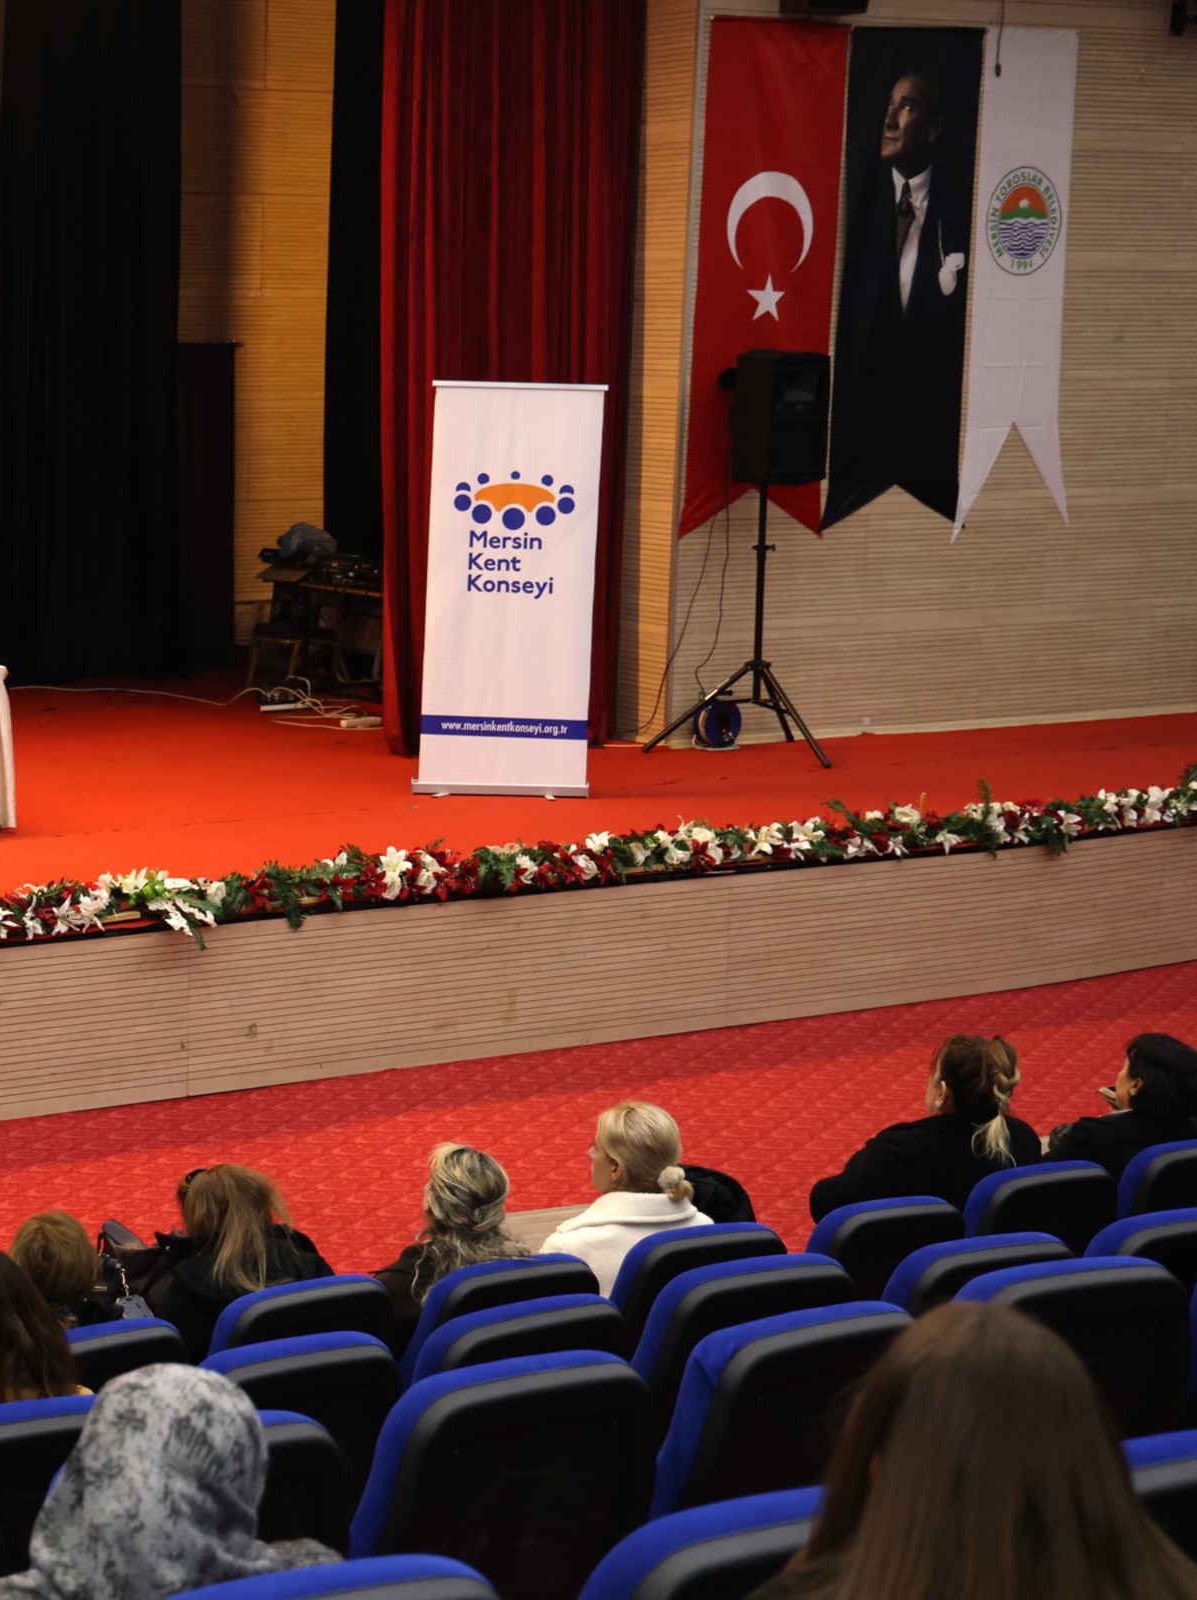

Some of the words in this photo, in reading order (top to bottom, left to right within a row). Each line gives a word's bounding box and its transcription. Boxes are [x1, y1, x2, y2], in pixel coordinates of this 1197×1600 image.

[996, 172, 1043, 202] TOROSLAR
[468, 530, 543, 550] Mersin
[467, 552, 521, 572] Kent
[467, 573, 554, 600] Konseyi
[441, 719, 569, 737] www.mersinkentkonseyi.org.tr
